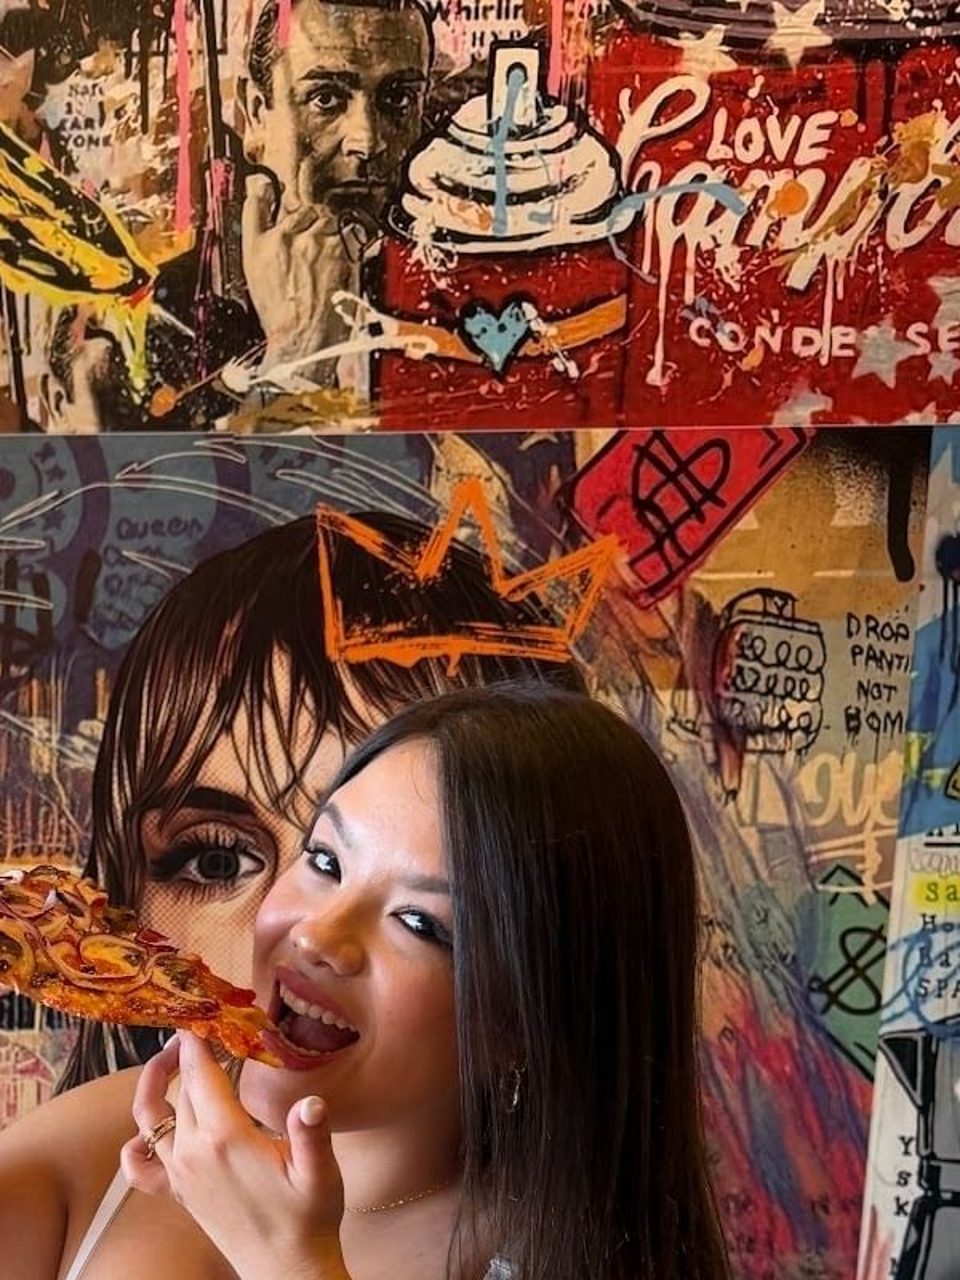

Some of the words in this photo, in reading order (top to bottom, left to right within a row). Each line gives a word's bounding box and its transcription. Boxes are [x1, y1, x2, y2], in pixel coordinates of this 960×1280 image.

[707, 107, 839, 165] LOVE
[689, 316, 960, 358] CONDESE
[846, 611, 910, 645] DROP
[857, 679, 897, 705] NOT
